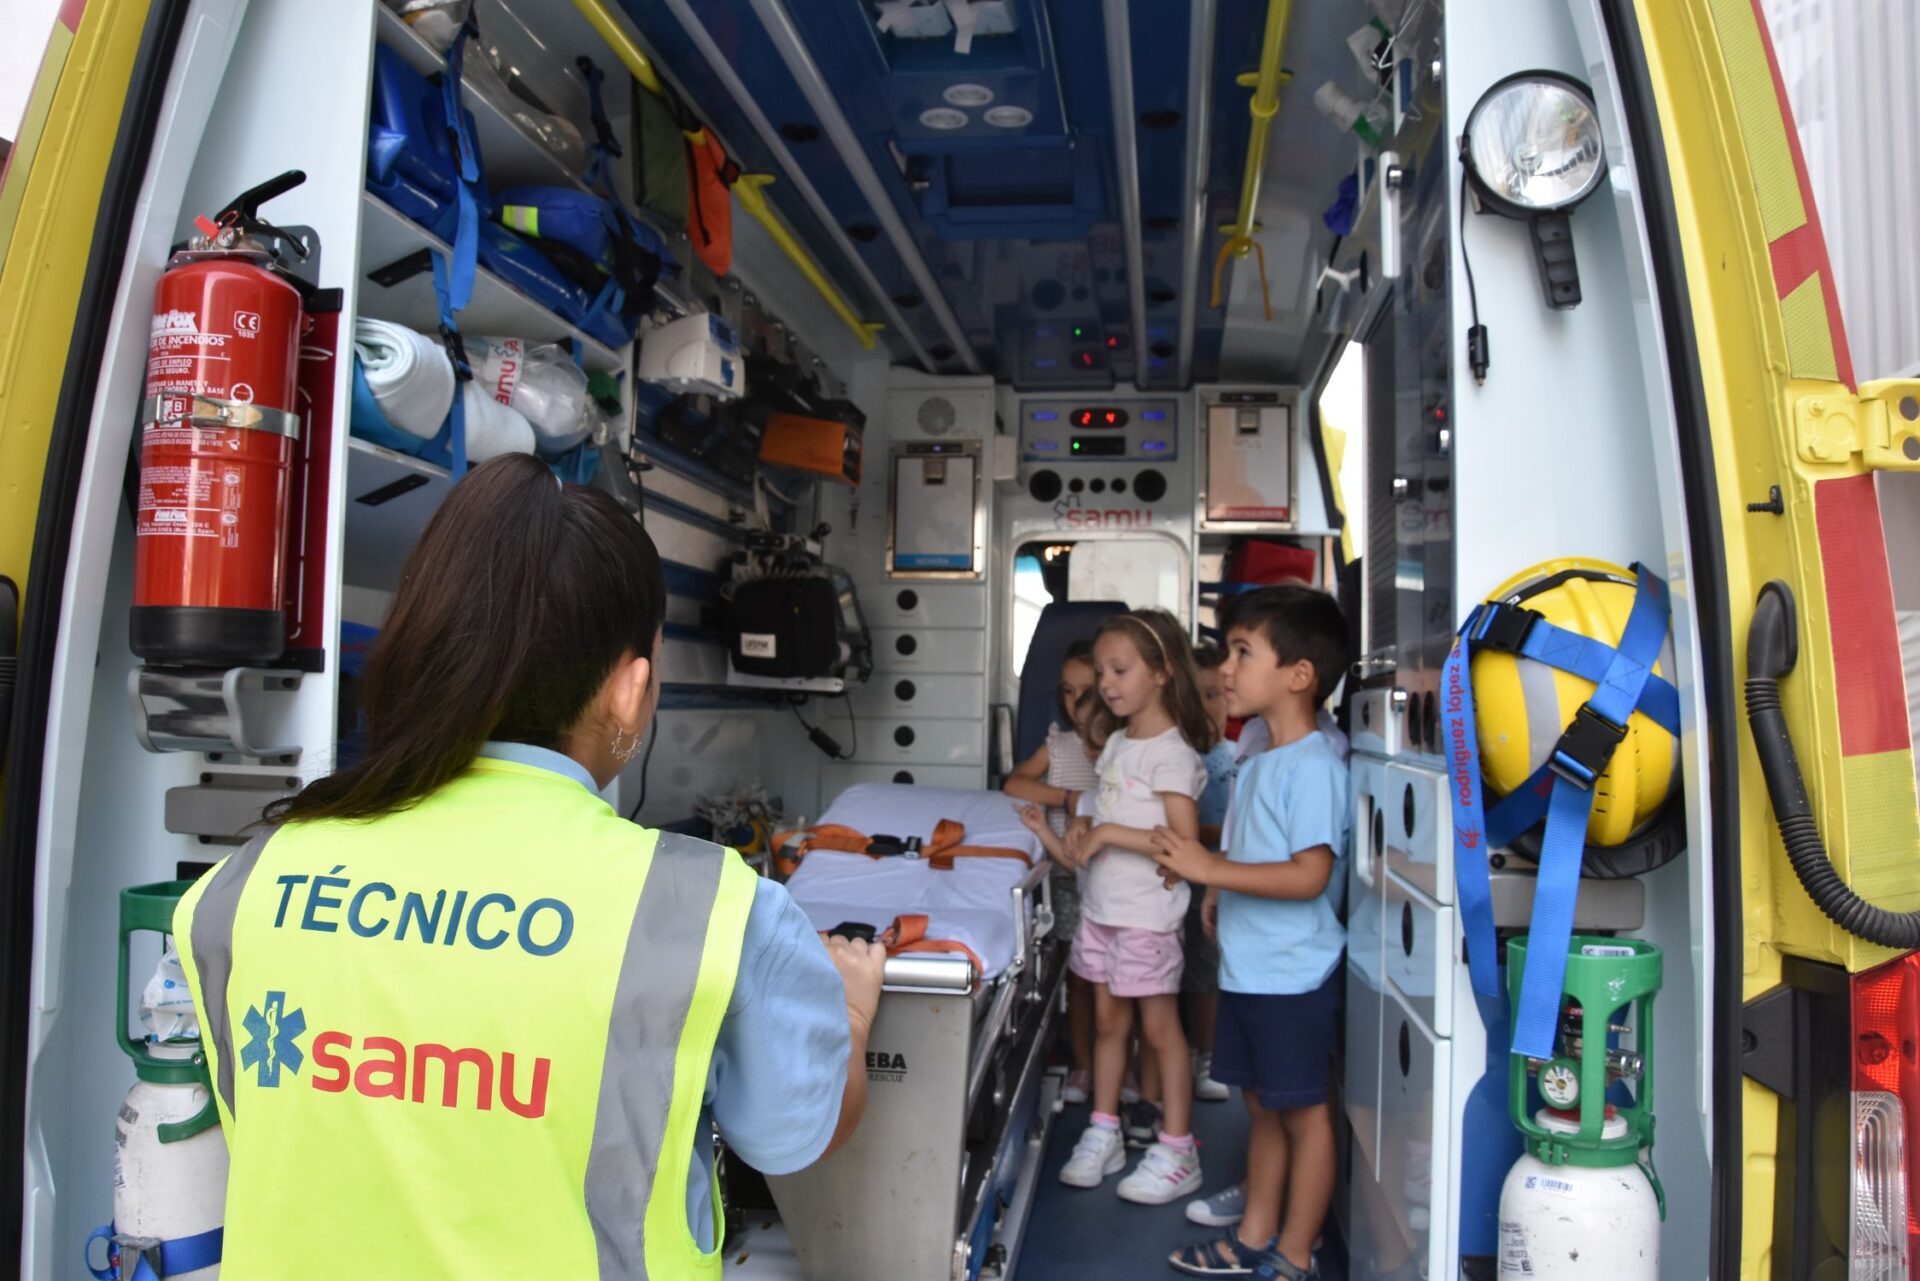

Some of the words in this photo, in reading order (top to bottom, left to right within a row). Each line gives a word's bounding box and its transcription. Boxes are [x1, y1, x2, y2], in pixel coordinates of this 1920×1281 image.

[168, 335, 225, 346] INCENDIOS
[495, 360, 517, 406] amu
[1066, 508, 1153, 529] samu
[1446, 663, 1466, 714] lópez
[1450, 718, 1473, 807] rodriguez
[274, 864, 574, 957] TÉCNICO
[311, 1030, 551, 1119] samu
